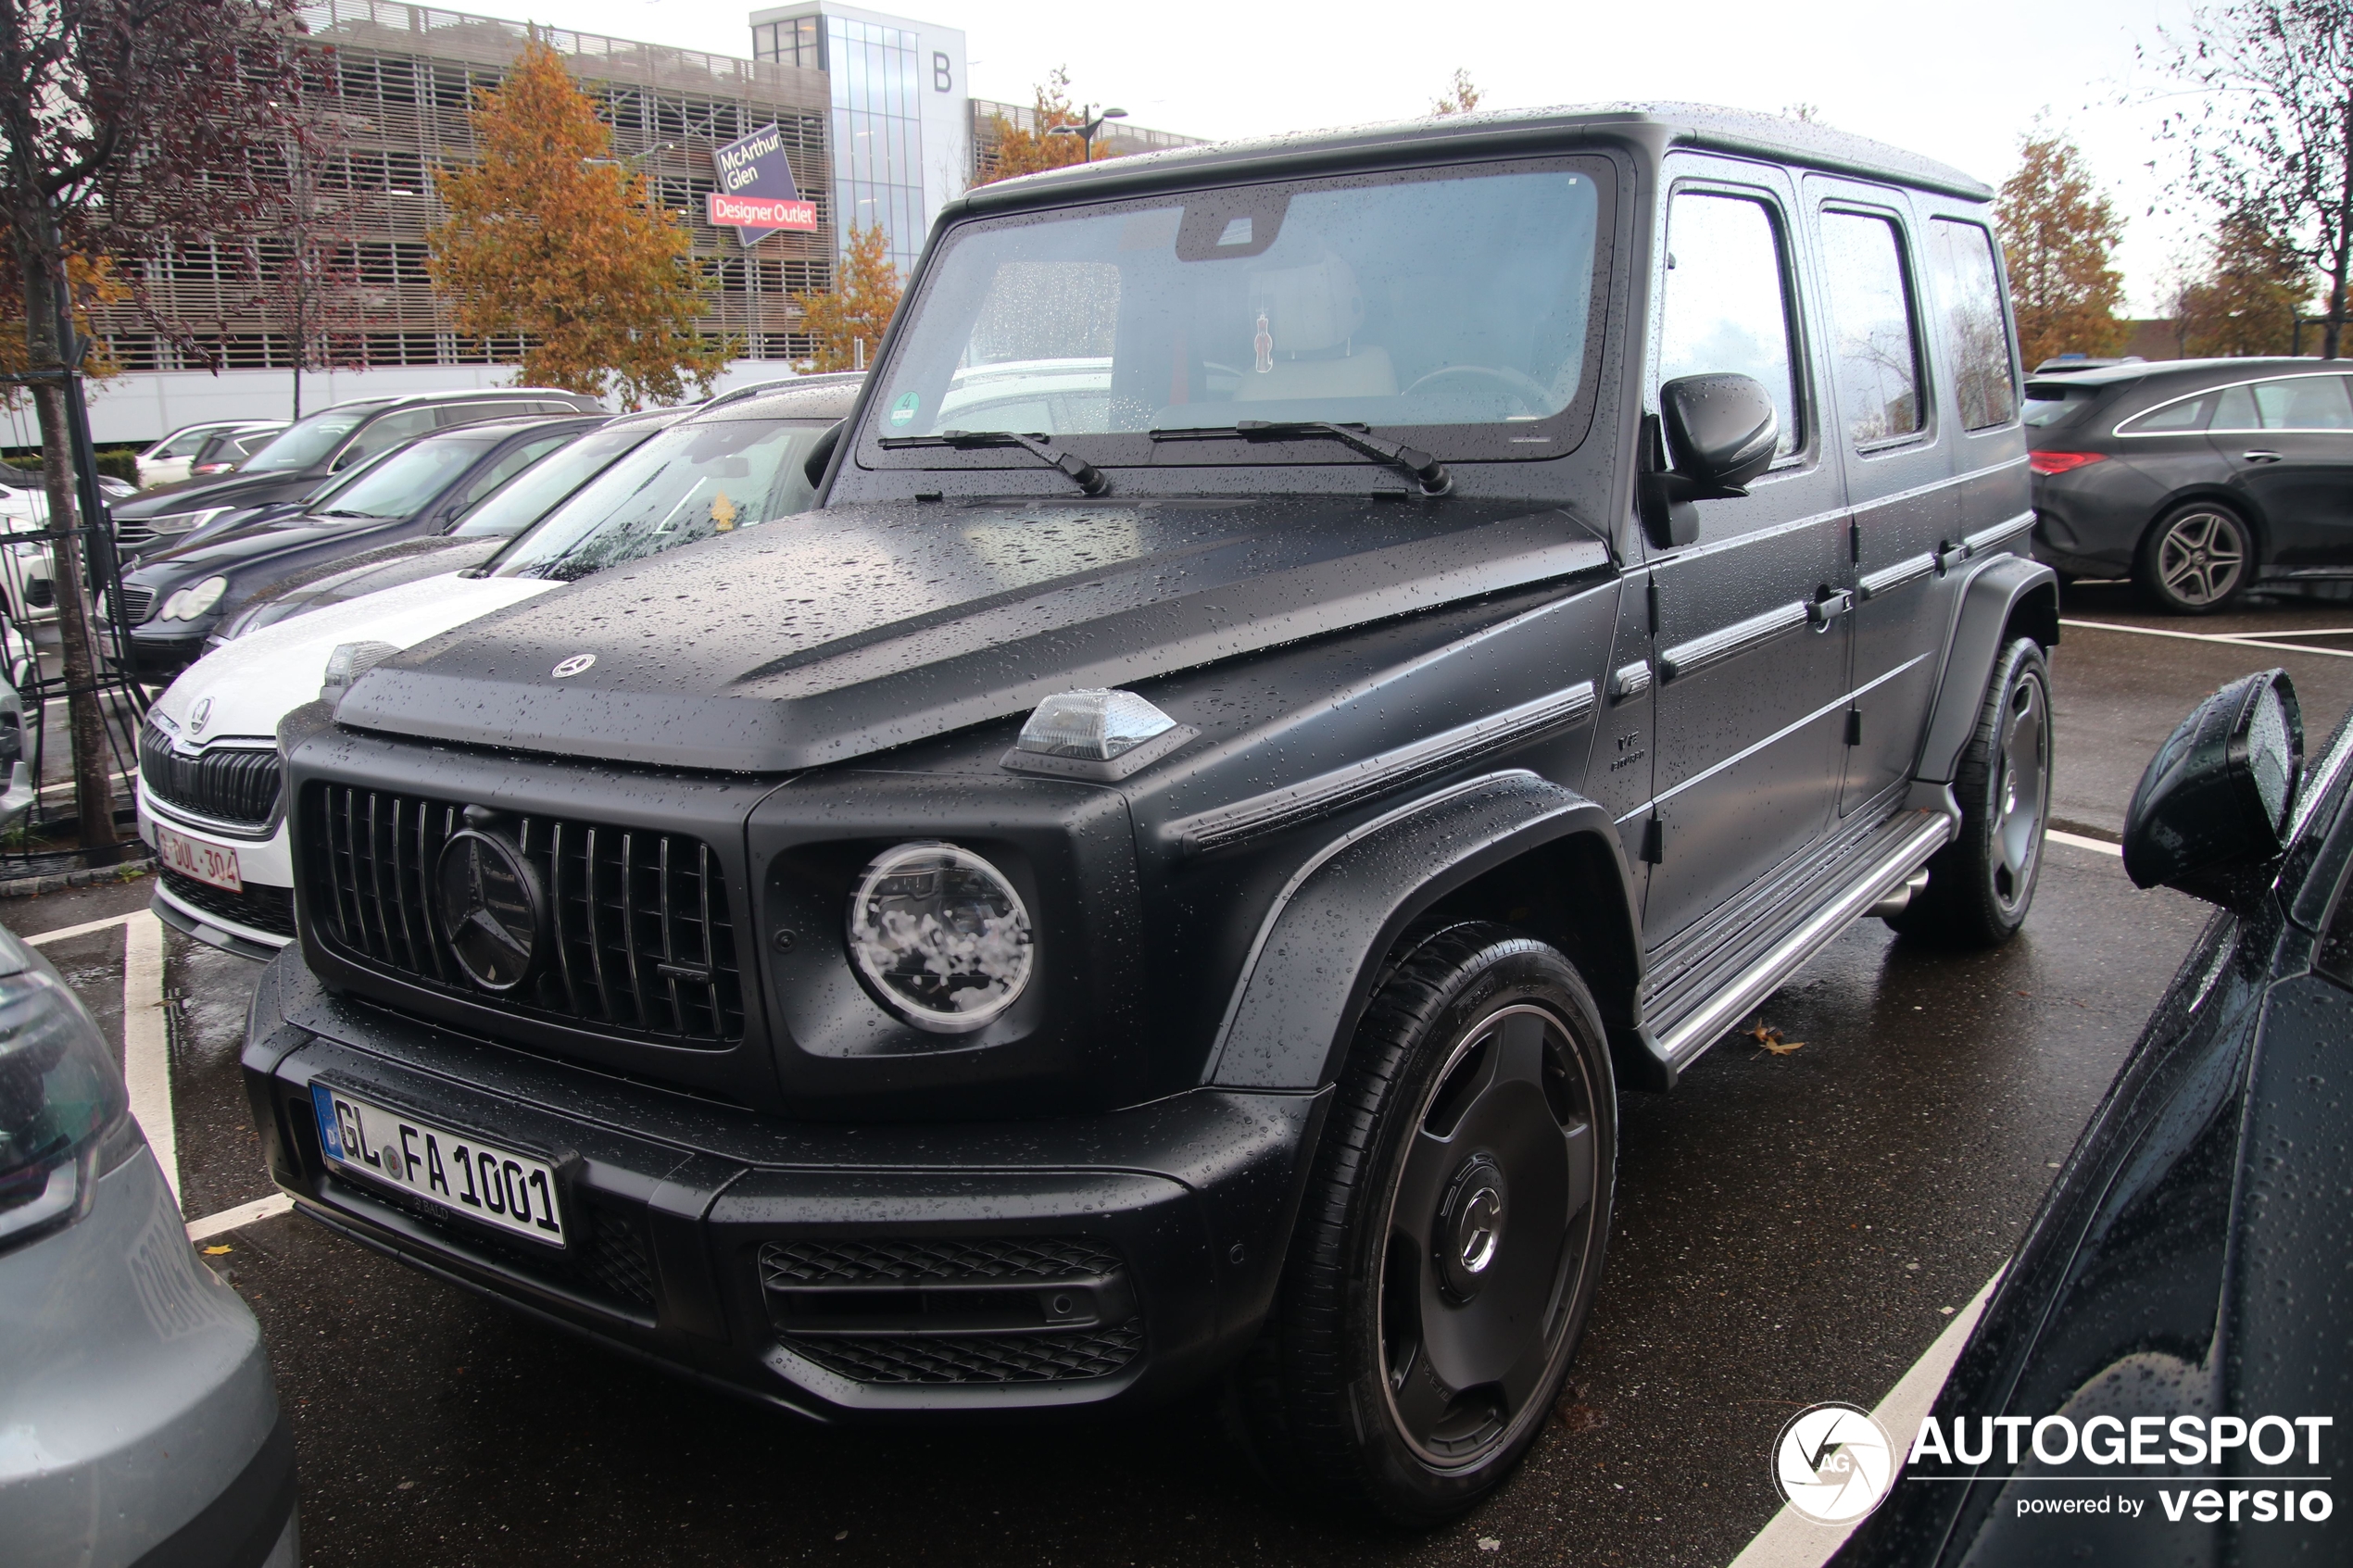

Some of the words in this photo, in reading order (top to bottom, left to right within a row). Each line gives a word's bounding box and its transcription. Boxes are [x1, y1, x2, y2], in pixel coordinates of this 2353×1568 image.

[932, 51, 952, 94] B
[720, 132, 780, 173] McArthur
[726, 165, 759, 191] Glen
[715, 198, 774, 224] Designer
[774, 203, 813, 224] Outlet
[901, 393, 912, 409] 4
[327, 1128, 336, 1146] D
[334, 1098, 382, 1168] GL
[422, 1199, 448, 1220] BALD
